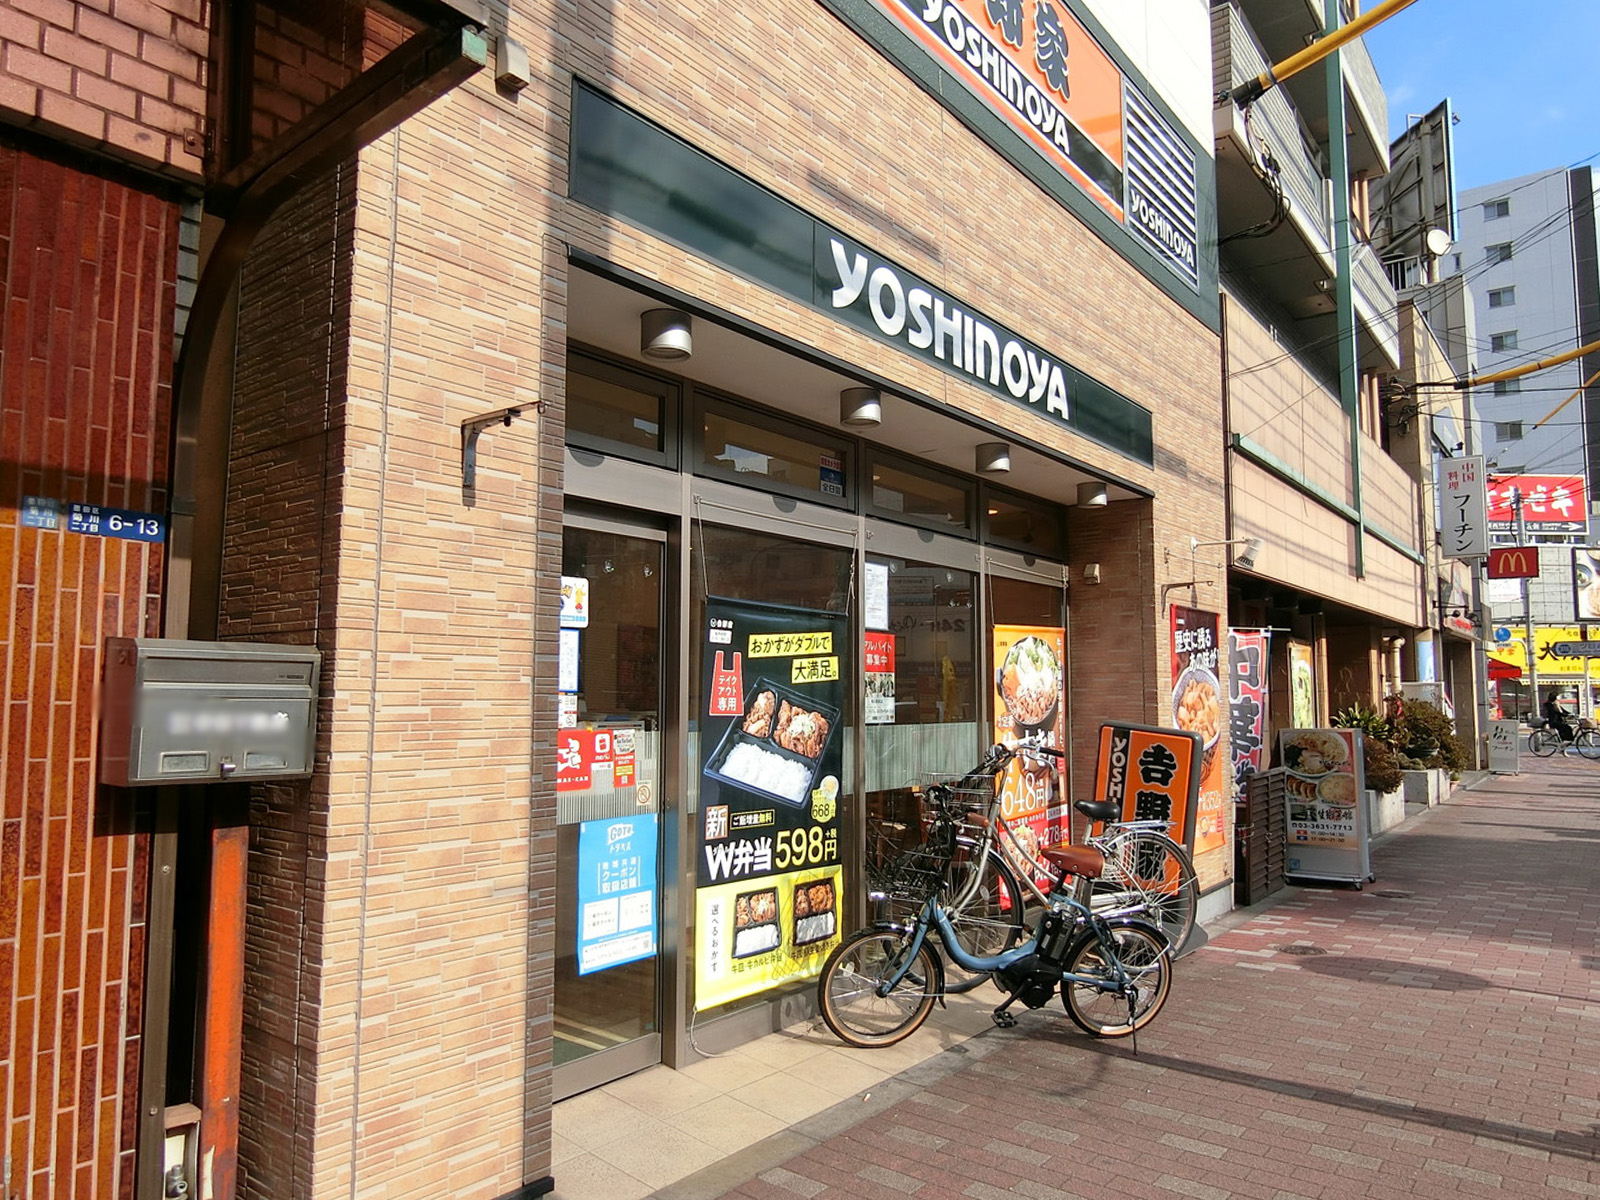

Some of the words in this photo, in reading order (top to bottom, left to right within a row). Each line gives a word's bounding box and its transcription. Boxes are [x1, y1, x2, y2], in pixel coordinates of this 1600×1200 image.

[1130, 188, 1195, 268] YOSHINOYA
[830, 238, 1069, 421] YOSHINOYA
[71, 521, 99, 533] 二丁目
[109, 514, 159, 536] 6-13
[1453, 494, 1474, 552] フーチン
[750, 635, 830, 654] おかずがダブルで
[1174, 627, 1212, 654] 歴史に残る
[794, 659, 837, 681] 大満足。
[866, 653, 888, 666] 募集中
[718, 675, 738, 685] テイク
[718, 686, 737, 696] アウト
[717, 697, 737, 712] 専用
[1109, 736, 1127, 803] YOSH
[812, 803, 830, 818] 668
[706, 806, 728, 839] 新
[705, 836, 773, 881] W弁当
[602, 866, 637, 881] クーポン
